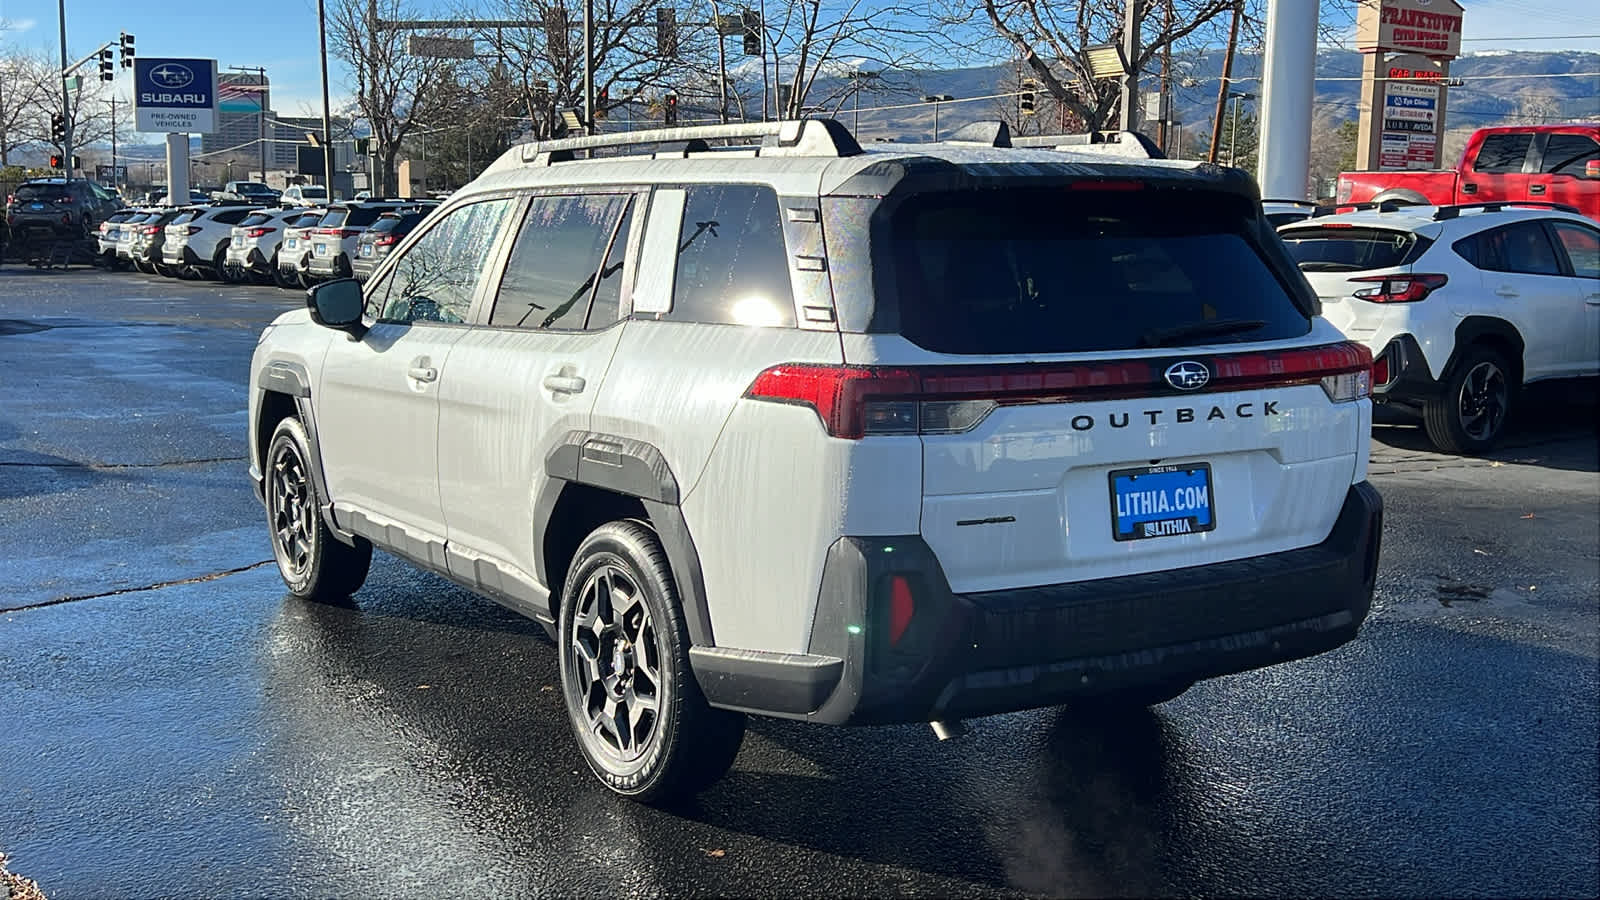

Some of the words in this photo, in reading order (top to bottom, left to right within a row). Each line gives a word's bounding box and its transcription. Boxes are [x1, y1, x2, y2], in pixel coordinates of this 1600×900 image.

[1381, 5, 1462, 33] FRANKTOWN
[142, 93, 206, 104] SUBARU
[151, 112, 197, 121] PRE-OWNED
[155, 120, 193, 128] VEHICLES
[1071, 401, 1280, 431] OUTBACK
[1116, 485, 1209, 517] LITHIA.COM
[1154, 518, 1192, 536] LITHIA
